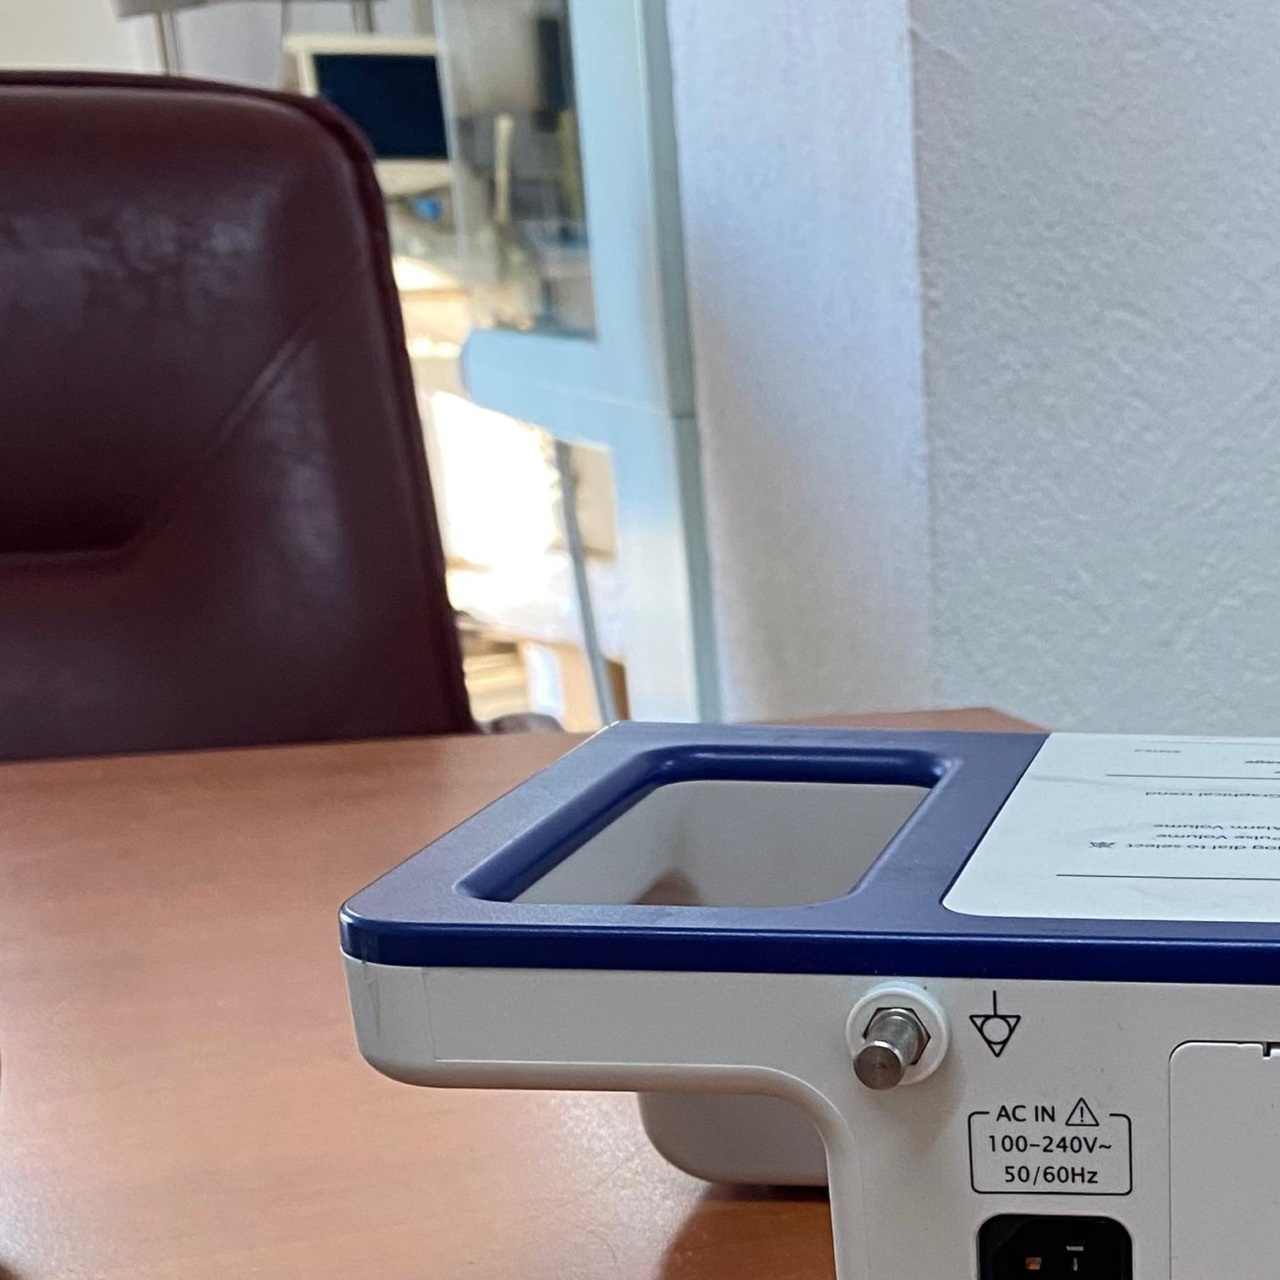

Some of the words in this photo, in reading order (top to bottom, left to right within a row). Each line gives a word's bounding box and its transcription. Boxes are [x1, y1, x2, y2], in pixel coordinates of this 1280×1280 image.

[996, 1104, 1026, 1122] AC
[1034, 1105, 1056, 1123] IN
[1004, 1165, 1098, 1185] 50/60Hz
